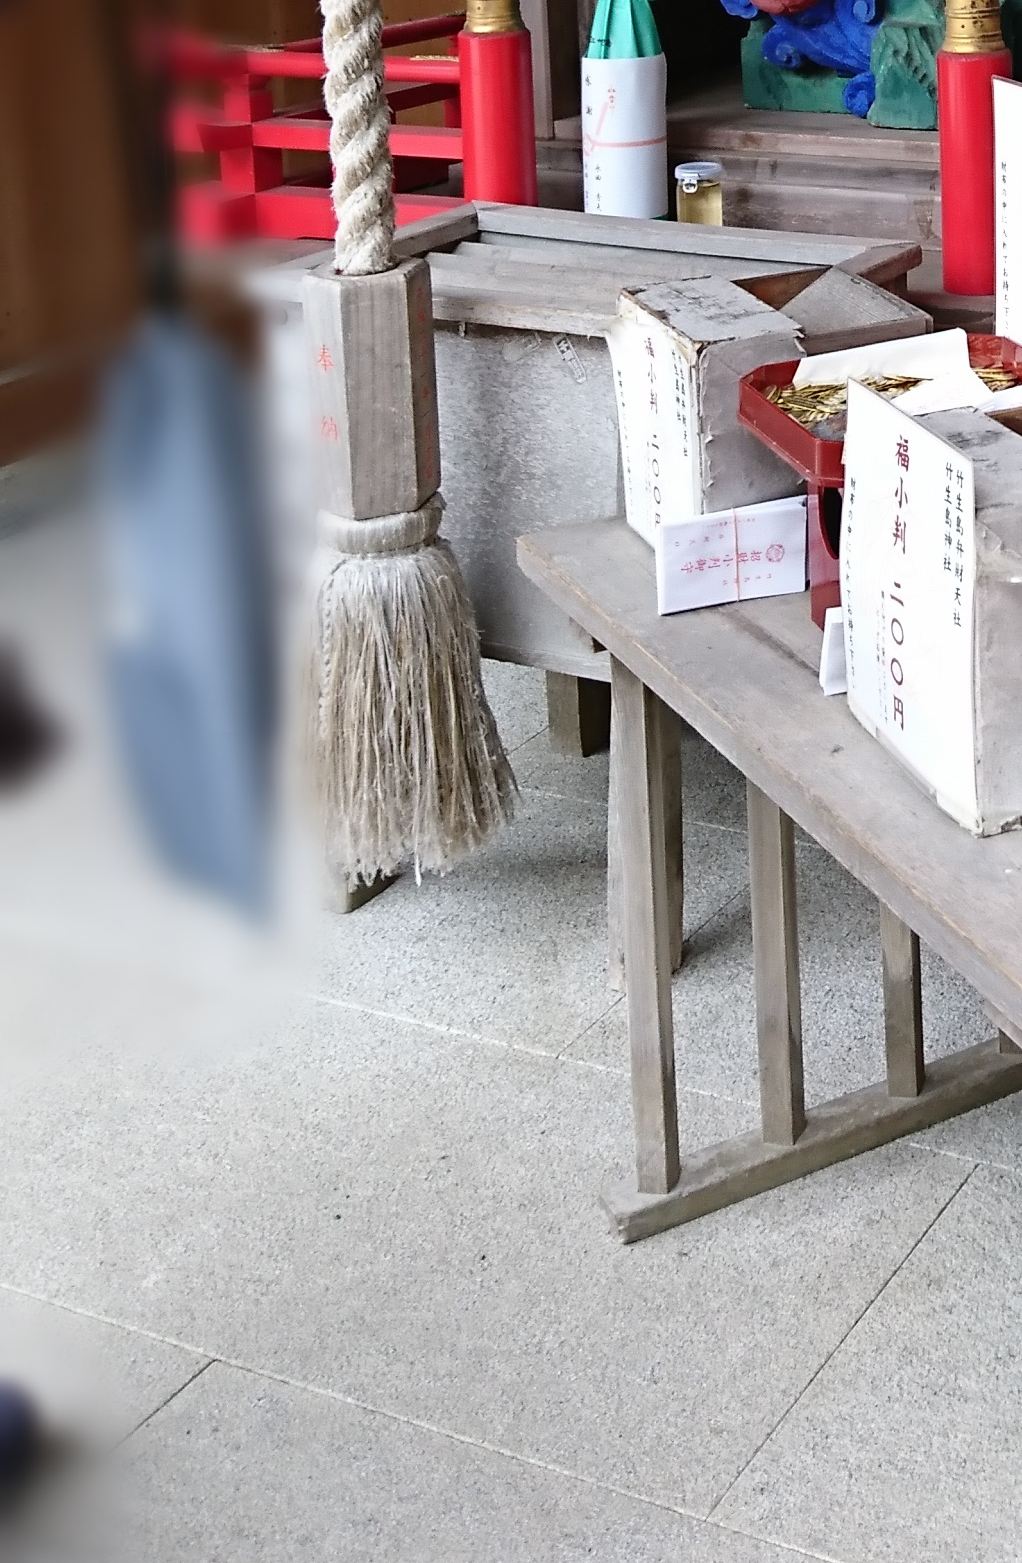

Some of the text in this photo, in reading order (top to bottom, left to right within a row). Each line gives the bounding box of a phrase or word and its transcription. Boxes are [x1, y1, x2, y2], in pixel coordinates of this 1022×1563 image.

[317, 344, 339, 442] 奉納
[892, 435, 910, 555] 福小判
[943, 462, 954, 572] 竹生島神社
[952, 469, 965, 628] 竹生島弁財天社
